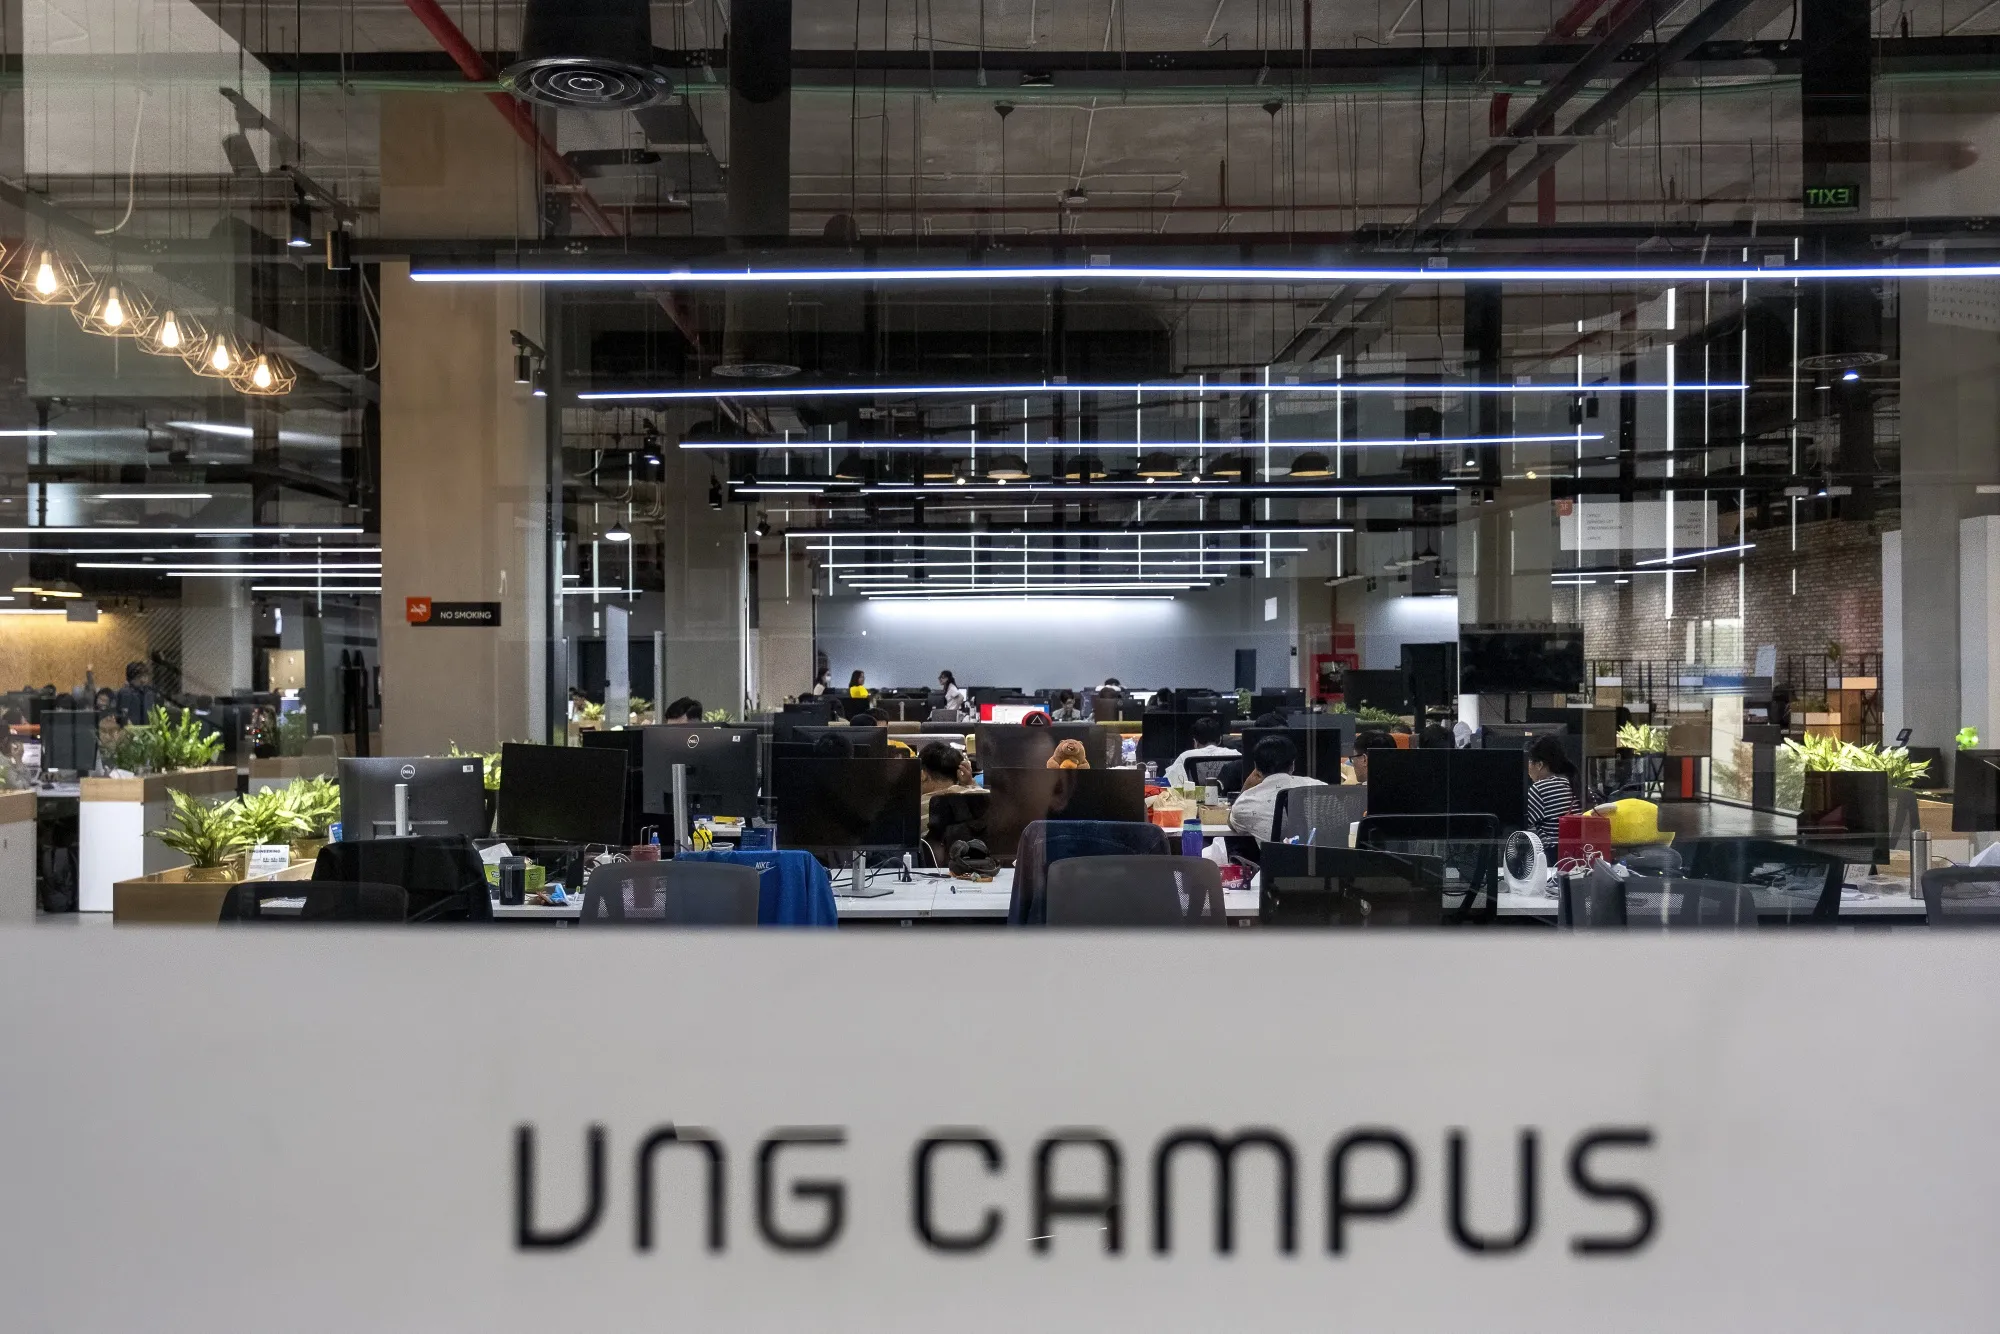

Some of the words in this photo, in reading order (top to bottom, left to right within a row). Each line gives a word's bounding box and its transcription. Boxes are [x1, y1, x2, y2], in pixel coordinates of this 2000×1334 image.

[440, 611, 453, 619] NO
[454, 611, 492, 619] SMOKING
[755, 861, 771, 870] NIKE
[511, 1121, 848, 1256] VNG
[910, 1121, 1660, 1260] CAMPUS
